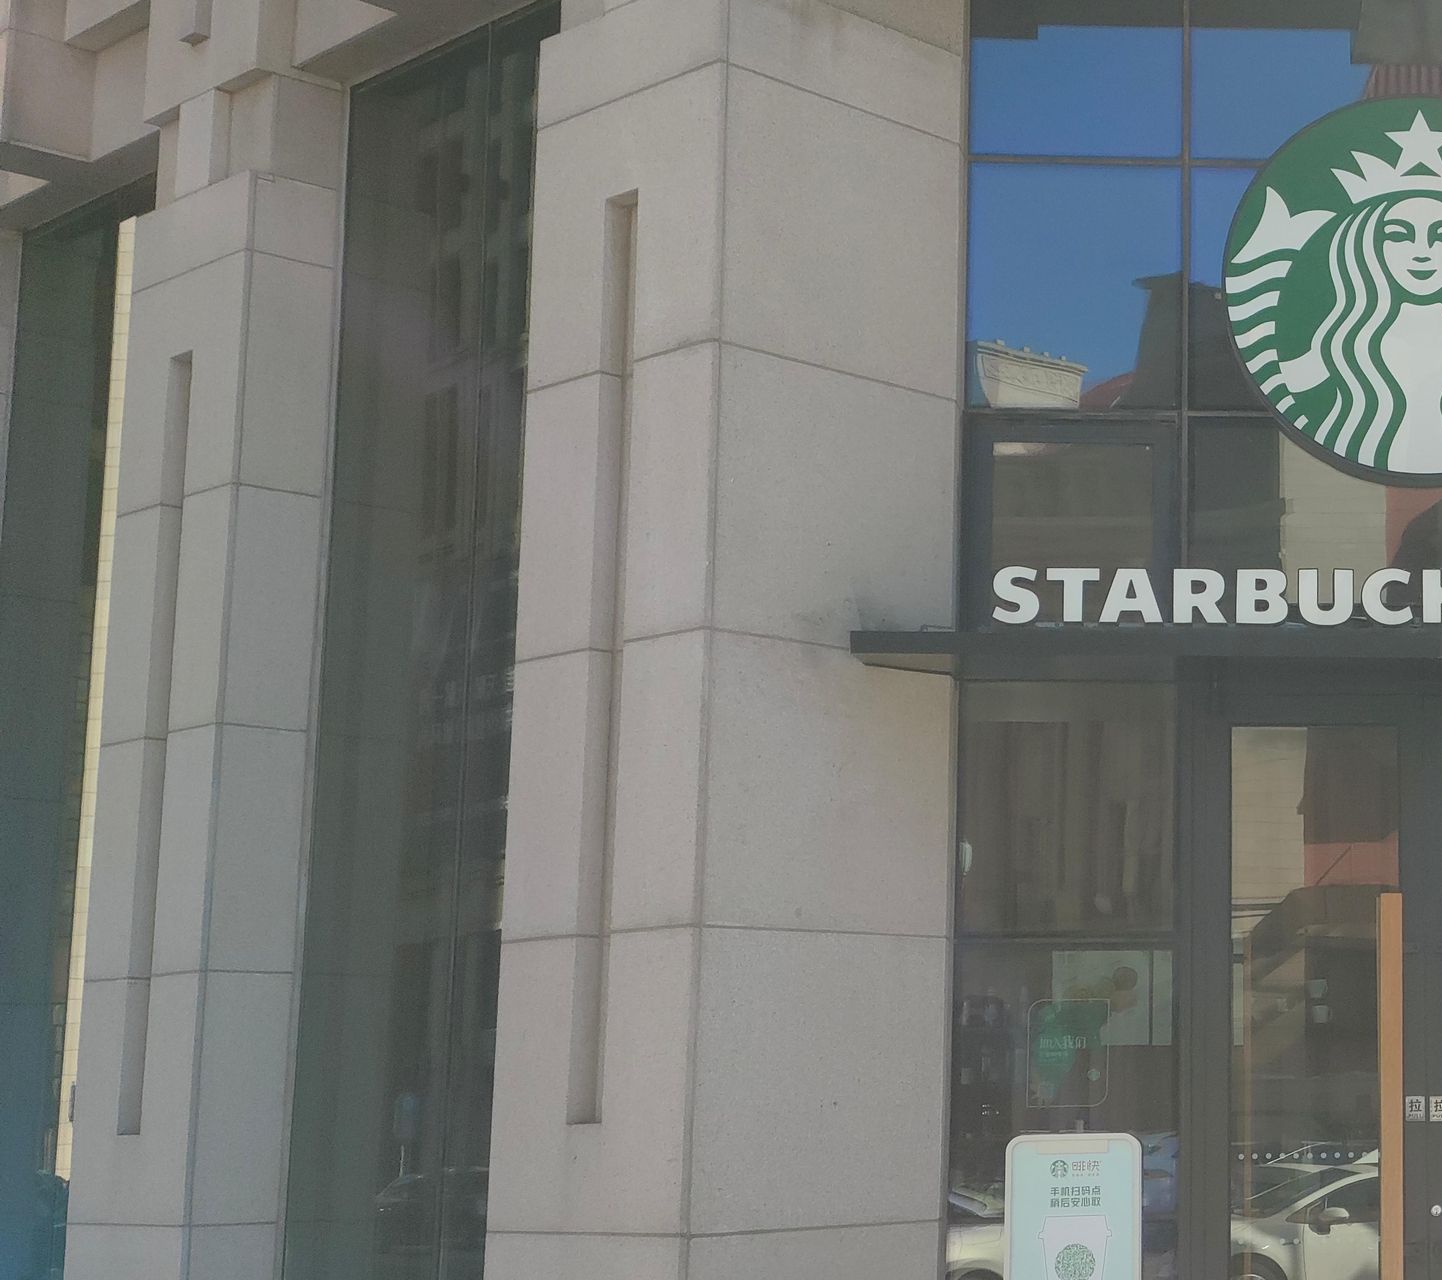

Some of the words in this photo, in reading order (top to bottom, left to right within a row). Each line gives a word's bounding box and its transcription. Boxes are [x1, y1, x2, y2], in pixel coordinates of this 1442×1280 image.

[1409, 1099, 1422, 1113] 拉
[1050, 1185, 1101, 1197] 手机扫码点
[1049, 1197, 1102, 1208] 稍后安心取
